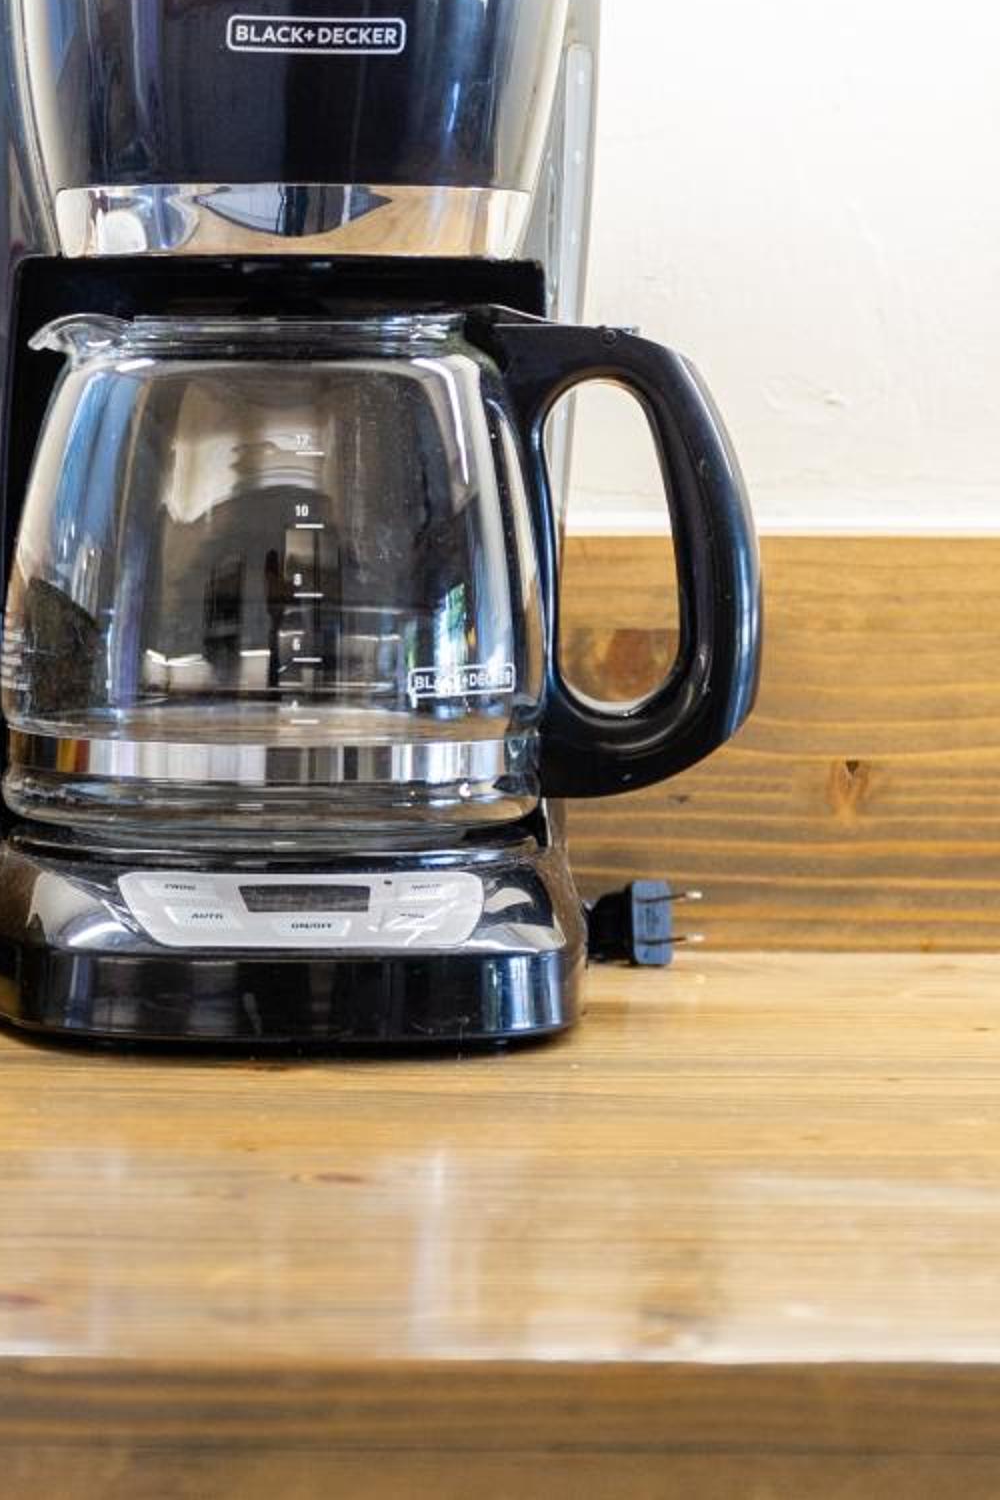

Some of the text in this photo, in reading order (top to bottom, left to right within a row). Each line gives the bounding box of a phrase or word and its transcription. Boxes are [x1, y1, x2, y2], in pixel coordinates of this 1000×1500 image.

[234, 25, 398, 45] BLACK+DECKER
[295, 505, 309, 517] 10
[293, 574, 302, 586] 8
[292, 638, 301, 650] 6
